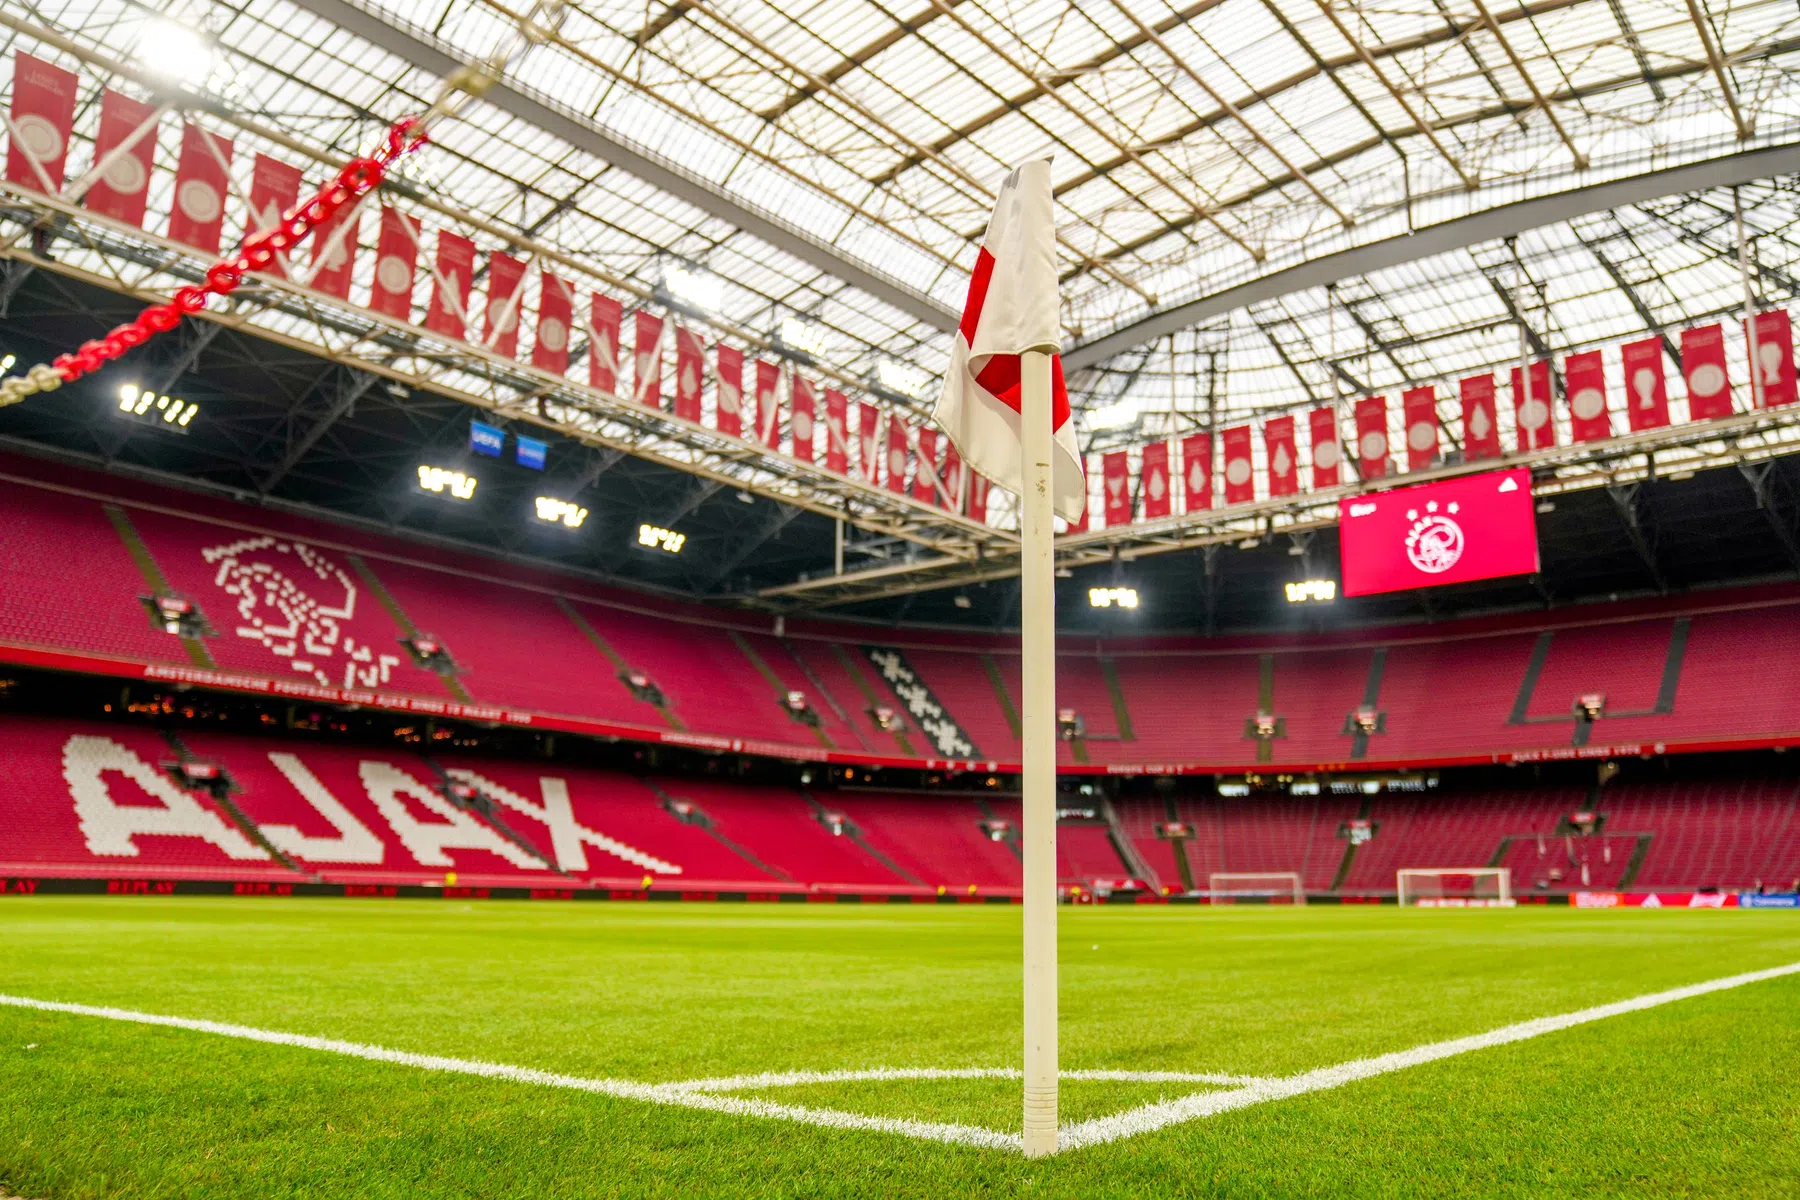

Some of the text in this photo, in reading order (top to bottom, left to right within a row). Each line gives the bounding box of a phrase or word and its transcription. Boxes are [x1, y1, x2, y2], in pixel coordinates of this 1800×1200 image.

[274, 680, 338, 700] FOOTBALL
[341, 691, 374, 704] CLUB
[376, 696, 408, 709] AJAX
[62, 734, 682, 874] AJAX
